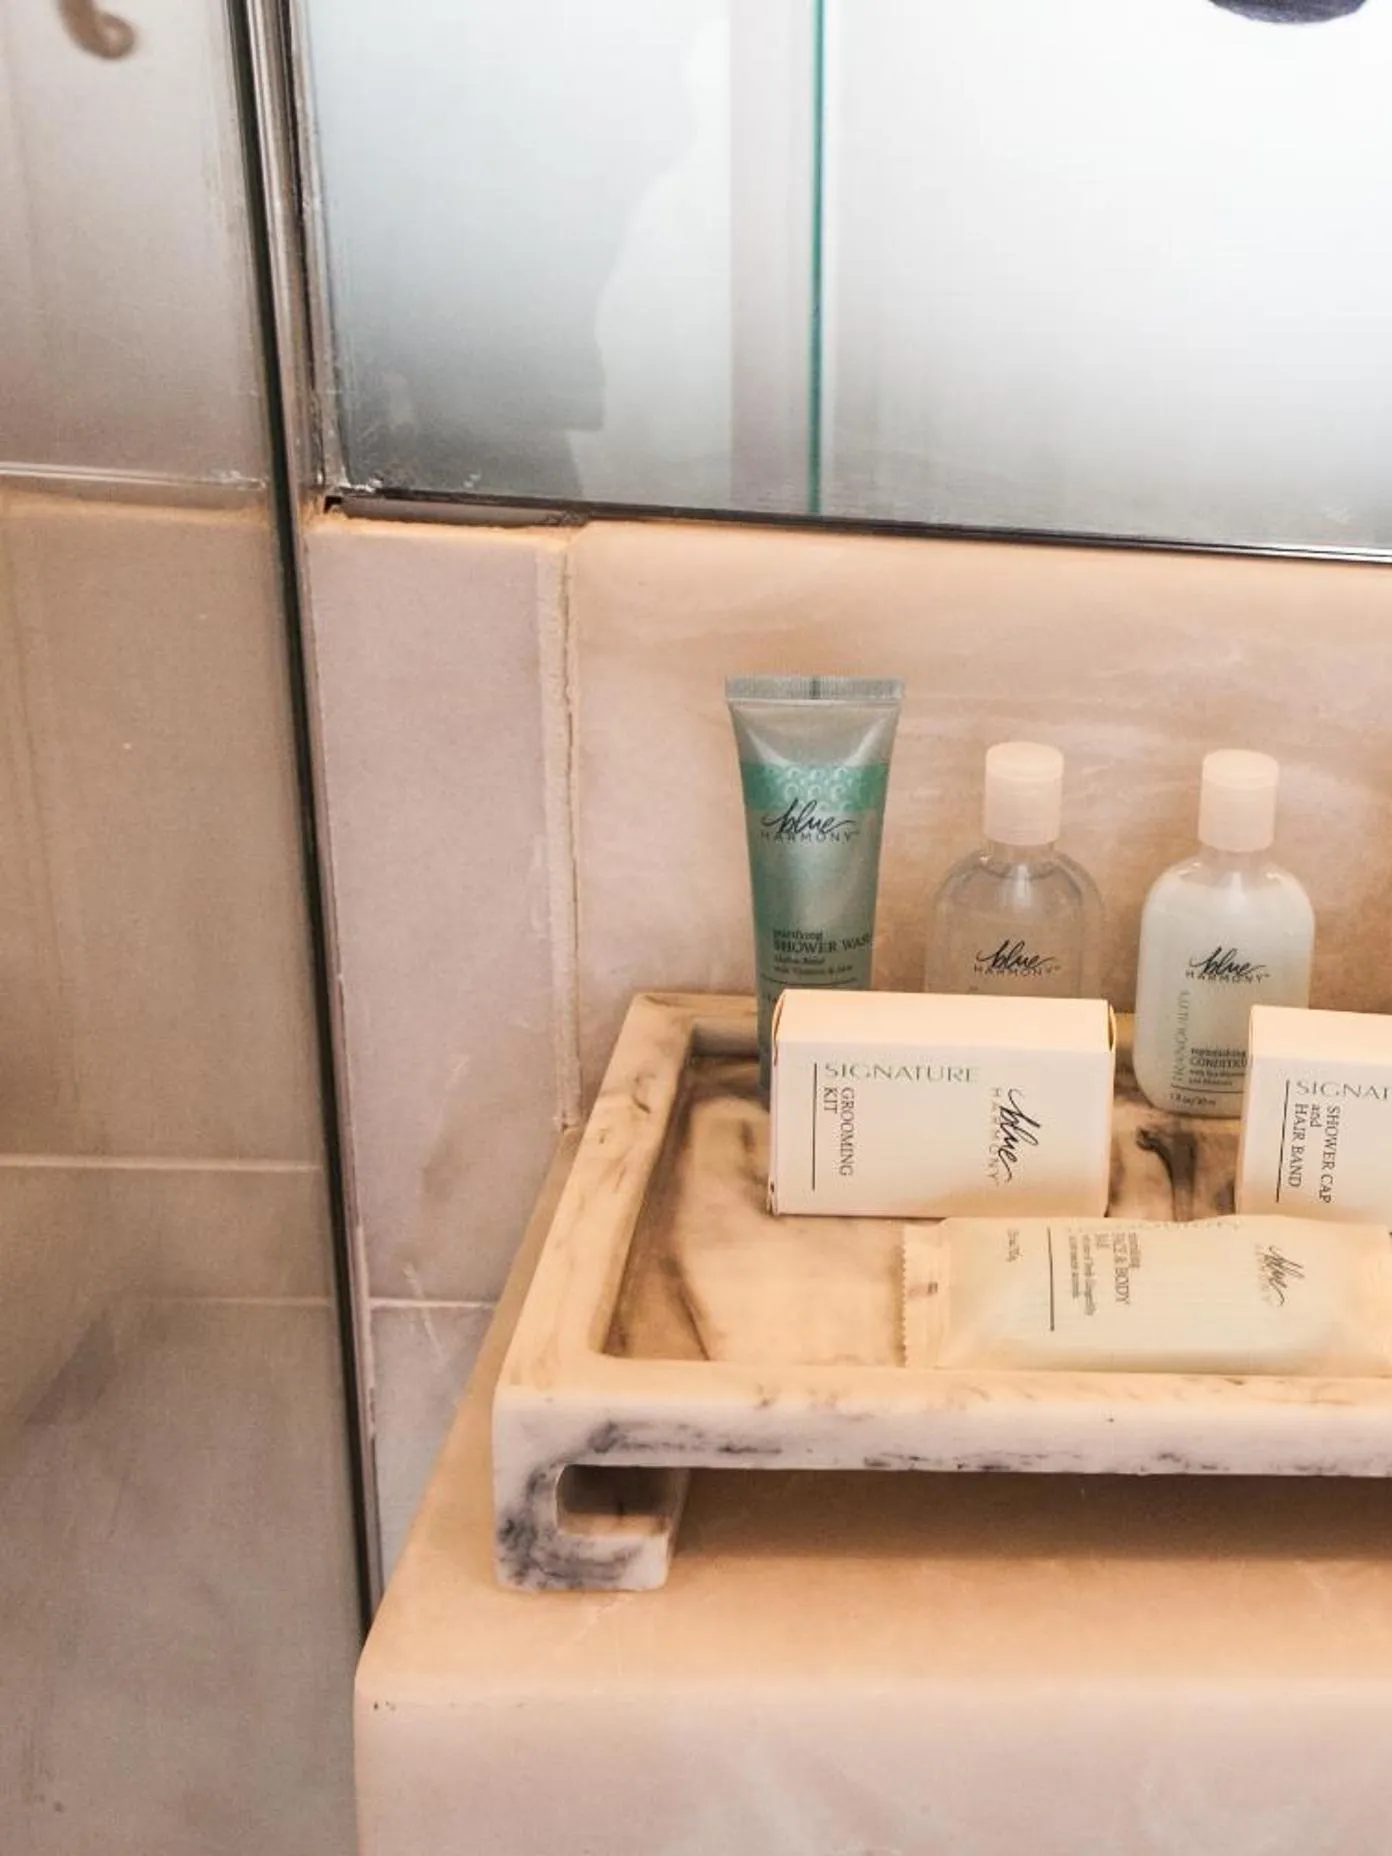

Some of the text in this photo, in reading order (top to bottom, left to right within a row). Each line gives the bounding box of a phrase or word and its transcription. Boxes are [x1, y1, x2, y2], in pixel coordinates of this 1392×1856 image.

[760, 797, 856, 836] blue
[760, 830, 854, 843] HARMONY
[773, 931, 873, 953] SHOWER WAS
[976, 939, 1057, 970] blue
[1188, 946, 1267, 976] blue
[824, 1063, 979, 1083] SIGNATURE
[823, 1086, 837, 1114] KIT
[839, 1086, 854, 1177] GROOMING
[1310, 1105, 1322, 1128] and
[998, 1087, 1042, 1183] blue
[1287, 1104, 1309, 1188] HAIR BAND
[1318, 1105, 1341, 1204] SHOWER CAP
[1115, 1267, 1129, 1304] BODY
